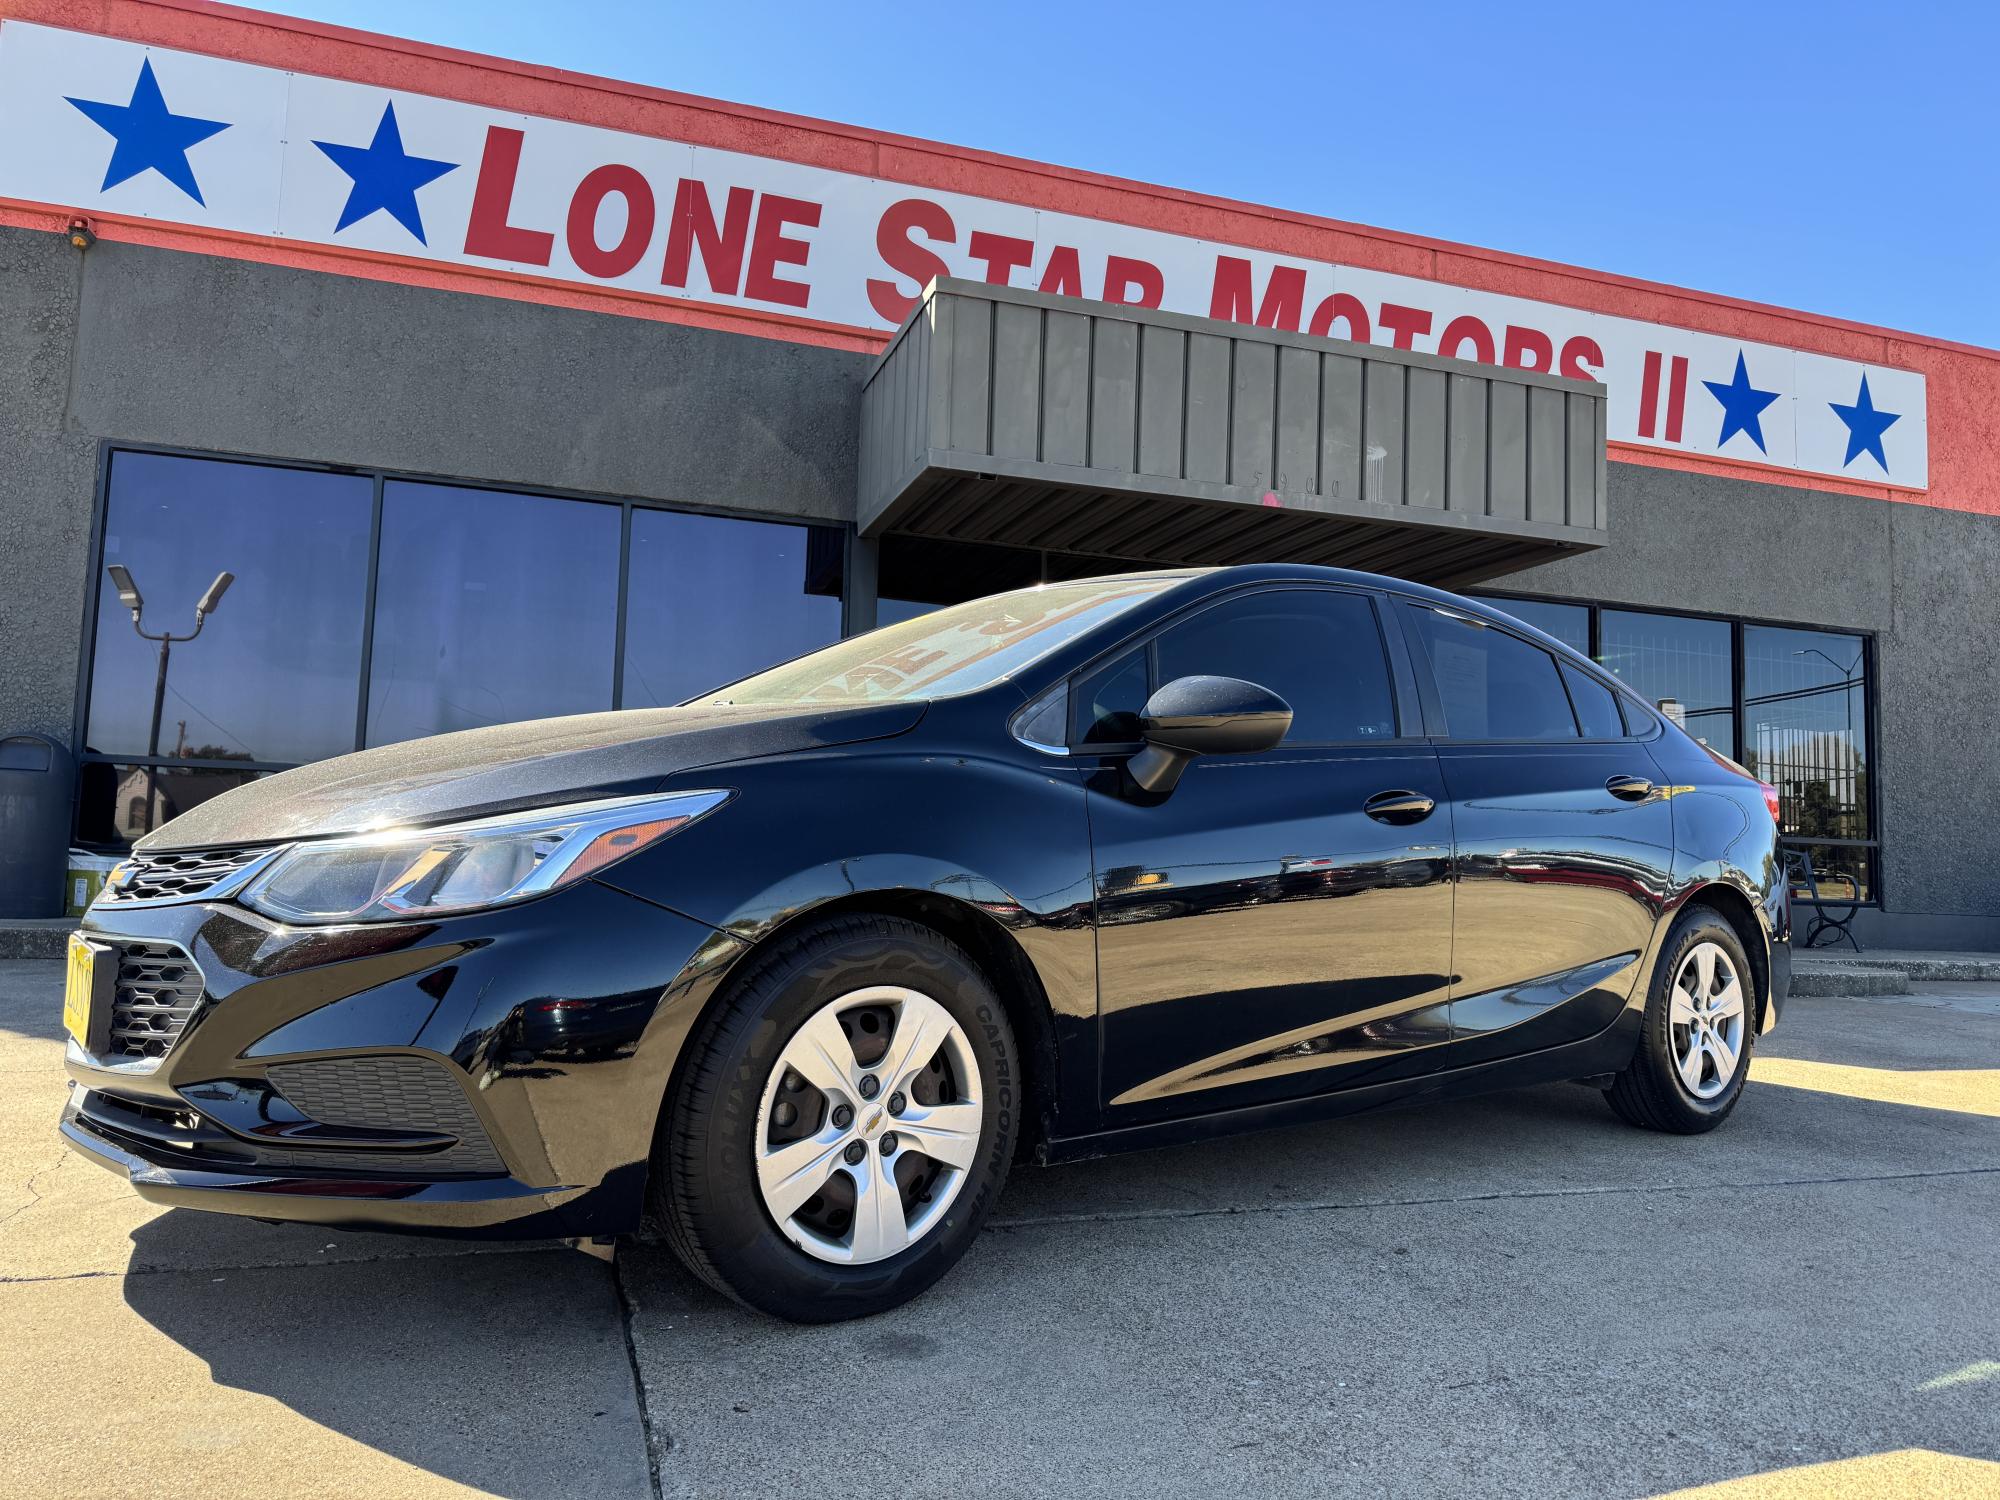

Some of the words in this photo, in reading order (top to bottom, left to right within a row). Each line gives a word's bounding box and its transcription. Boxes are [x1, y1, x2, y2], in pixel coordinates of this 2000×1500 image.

[463, 125, 822, 308] LONE
[1637, 350, 1689, 443] II
[975, 1004, 1011, 1179] CAPRICORN
